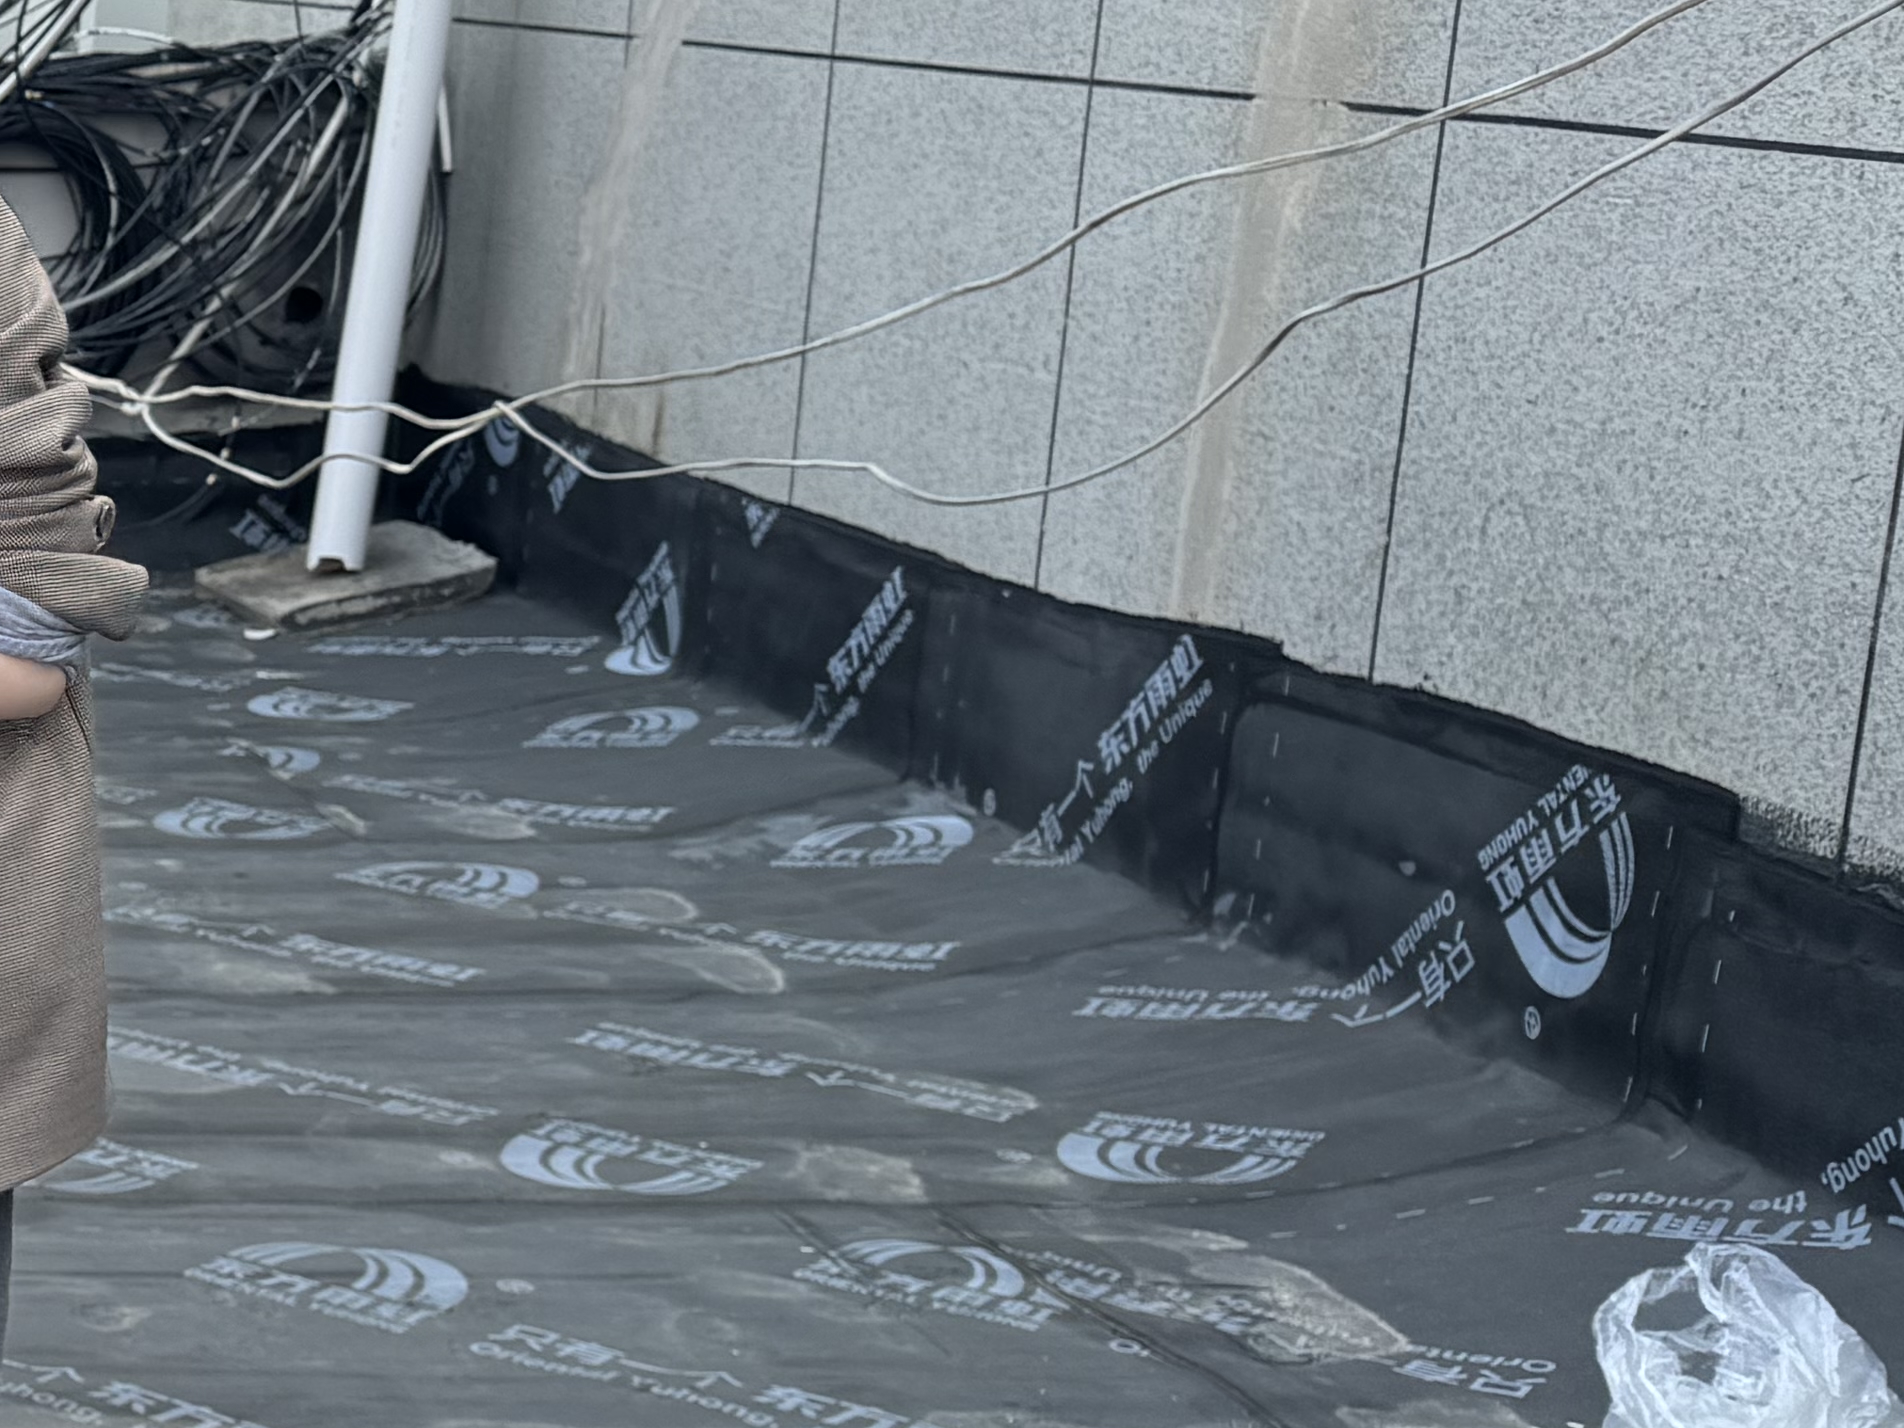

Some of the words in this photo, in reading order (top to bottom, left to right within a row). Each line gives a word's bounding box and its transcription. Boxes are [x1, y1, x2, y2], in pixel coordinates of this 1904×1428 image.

[1537, 763, 1593, 818] IENTAL
[1477, 808, 1540, 872] YUHONG
[1486, 774, 1622, 913] 东方雨虹
[1592, 1189, 1734, 1215] Unique
[1748, 1189, 1808, 1215] the
